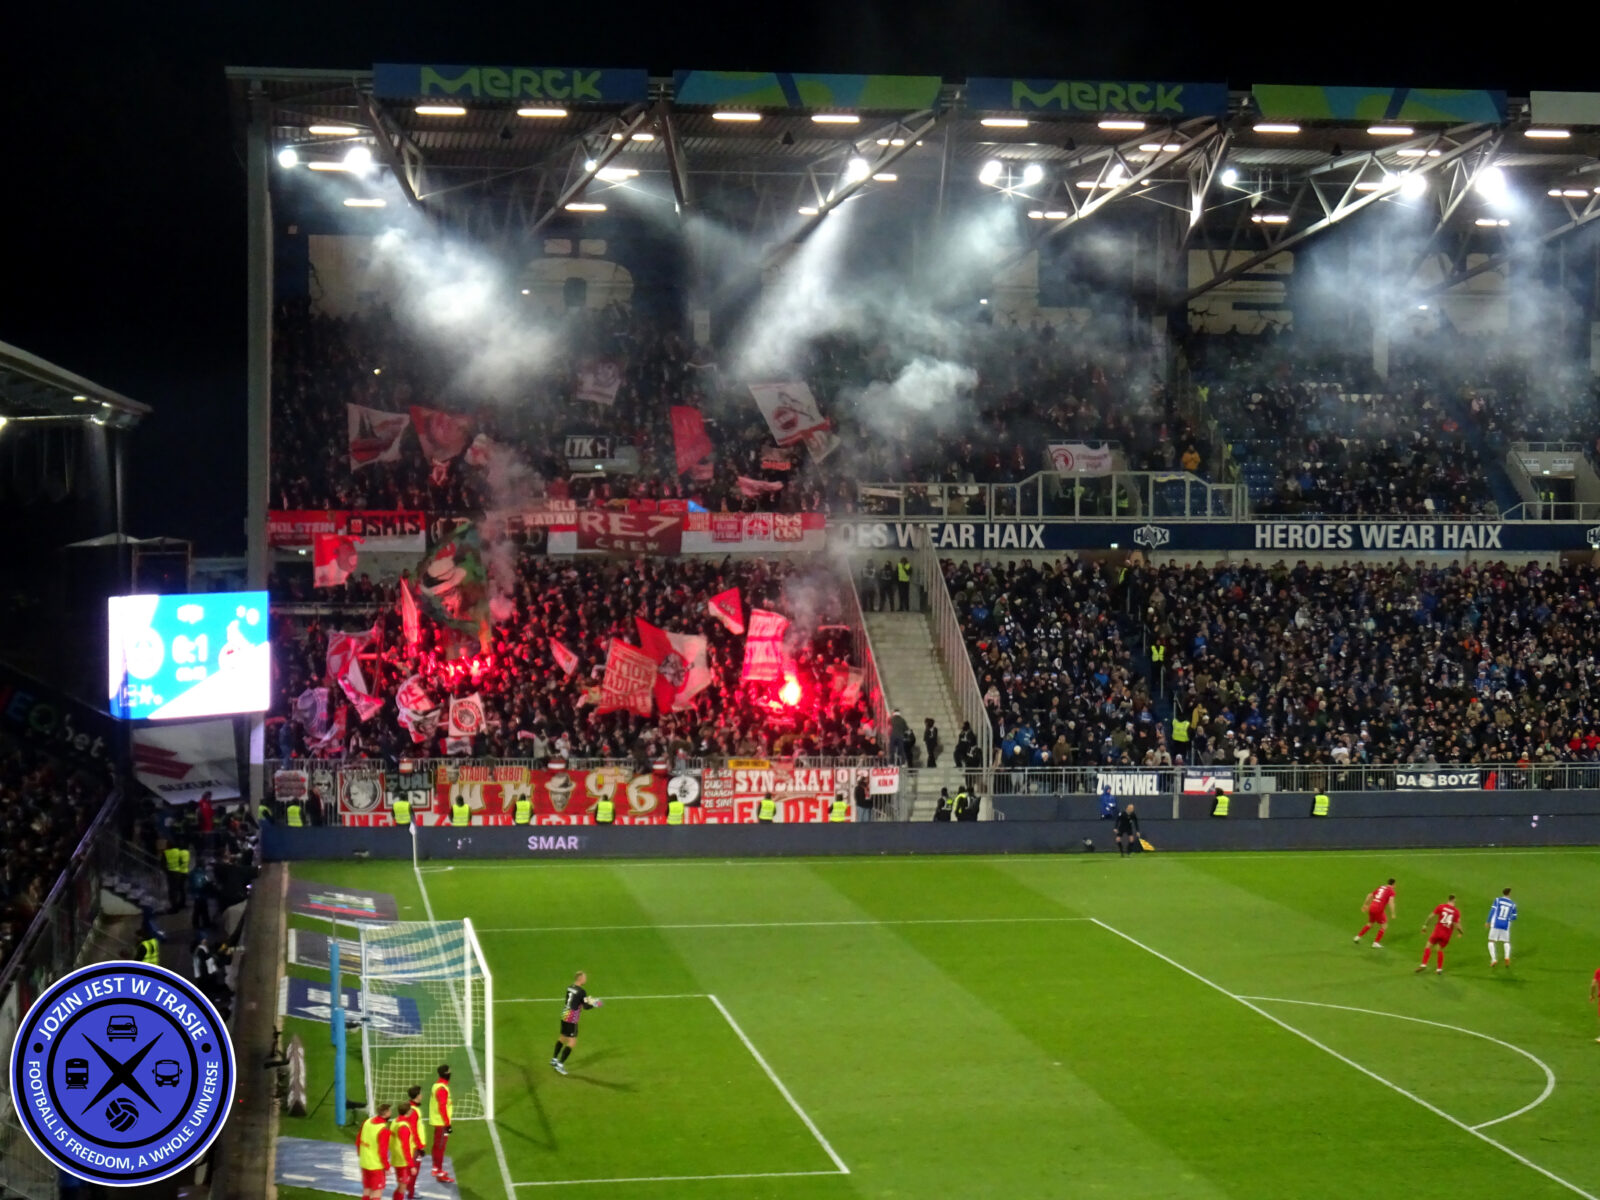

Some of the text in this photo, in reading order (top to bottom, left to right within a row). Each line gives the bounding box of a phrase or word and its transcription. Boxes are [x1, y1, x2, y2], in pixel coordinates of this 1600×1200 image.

[895, 522, 975, 549] WEAR
[983, 523, 1046, 549] HAIX
[1255, 524, 1503, 549] HEROES WEAR HAIX
[1396, 773, 1479, 786] DA BOYZ
[1440, 911, 1454, 927] 24
[1500, 905, 1510, 918] 11
